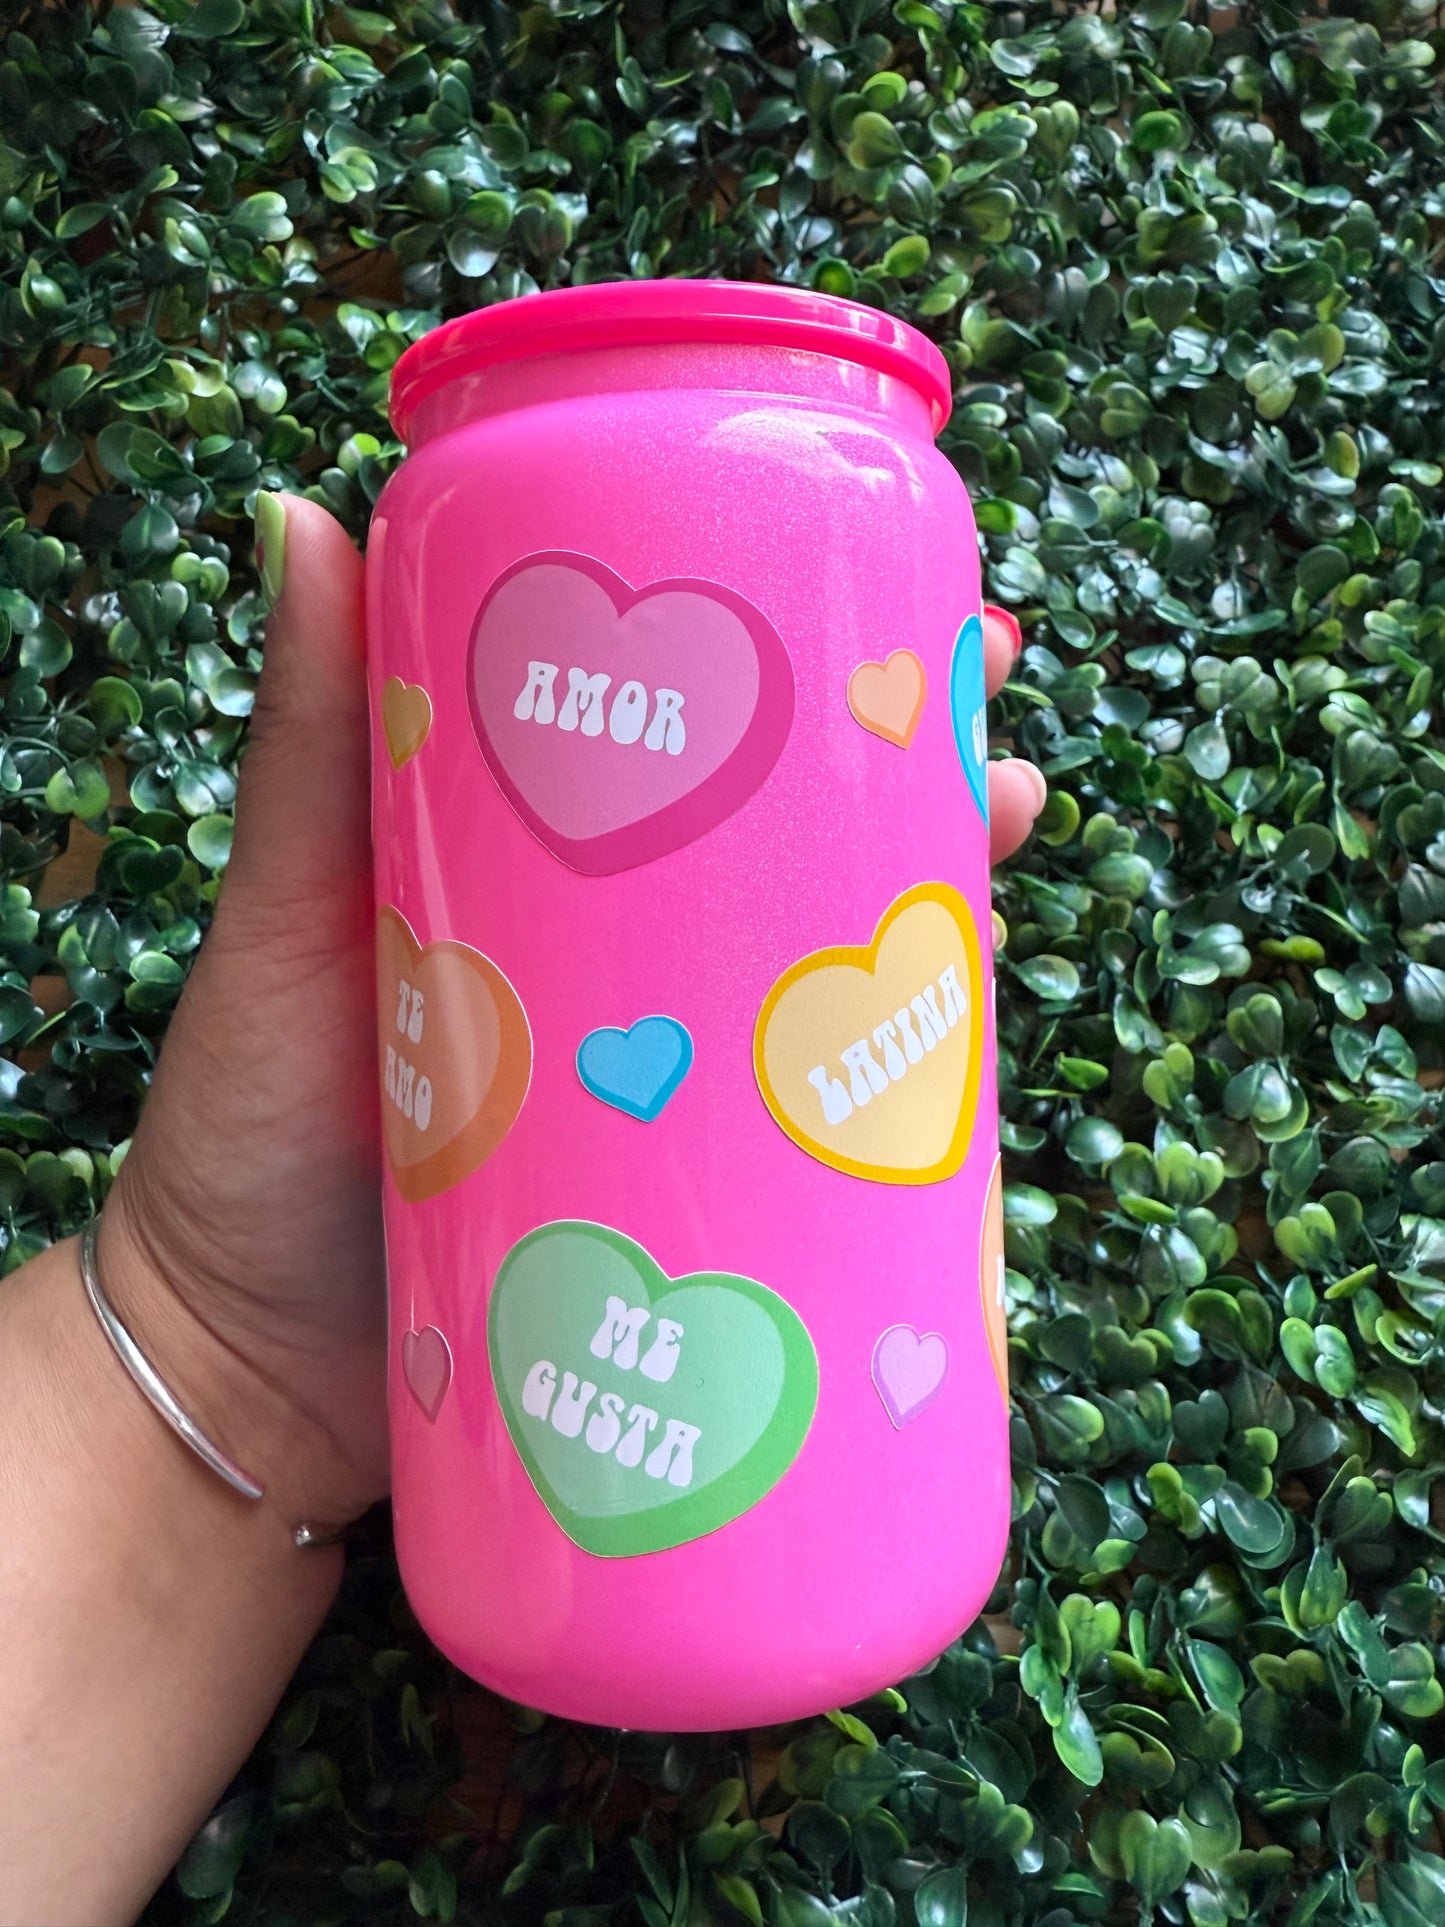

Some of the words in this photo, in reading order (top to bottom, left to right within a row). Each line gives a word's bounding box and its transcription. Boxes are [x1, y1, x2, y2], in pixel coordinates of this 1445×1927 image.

[513, 660, 686, 755] AMOR
[396, 979, 424, 1044] TE
[807, 964, 967, 1125] LATINA
[384, 1044, 432, 1131] AMO
[590, 1295, 684, 1383] ME
[521, 1359, 701, 1487] GUSTA
